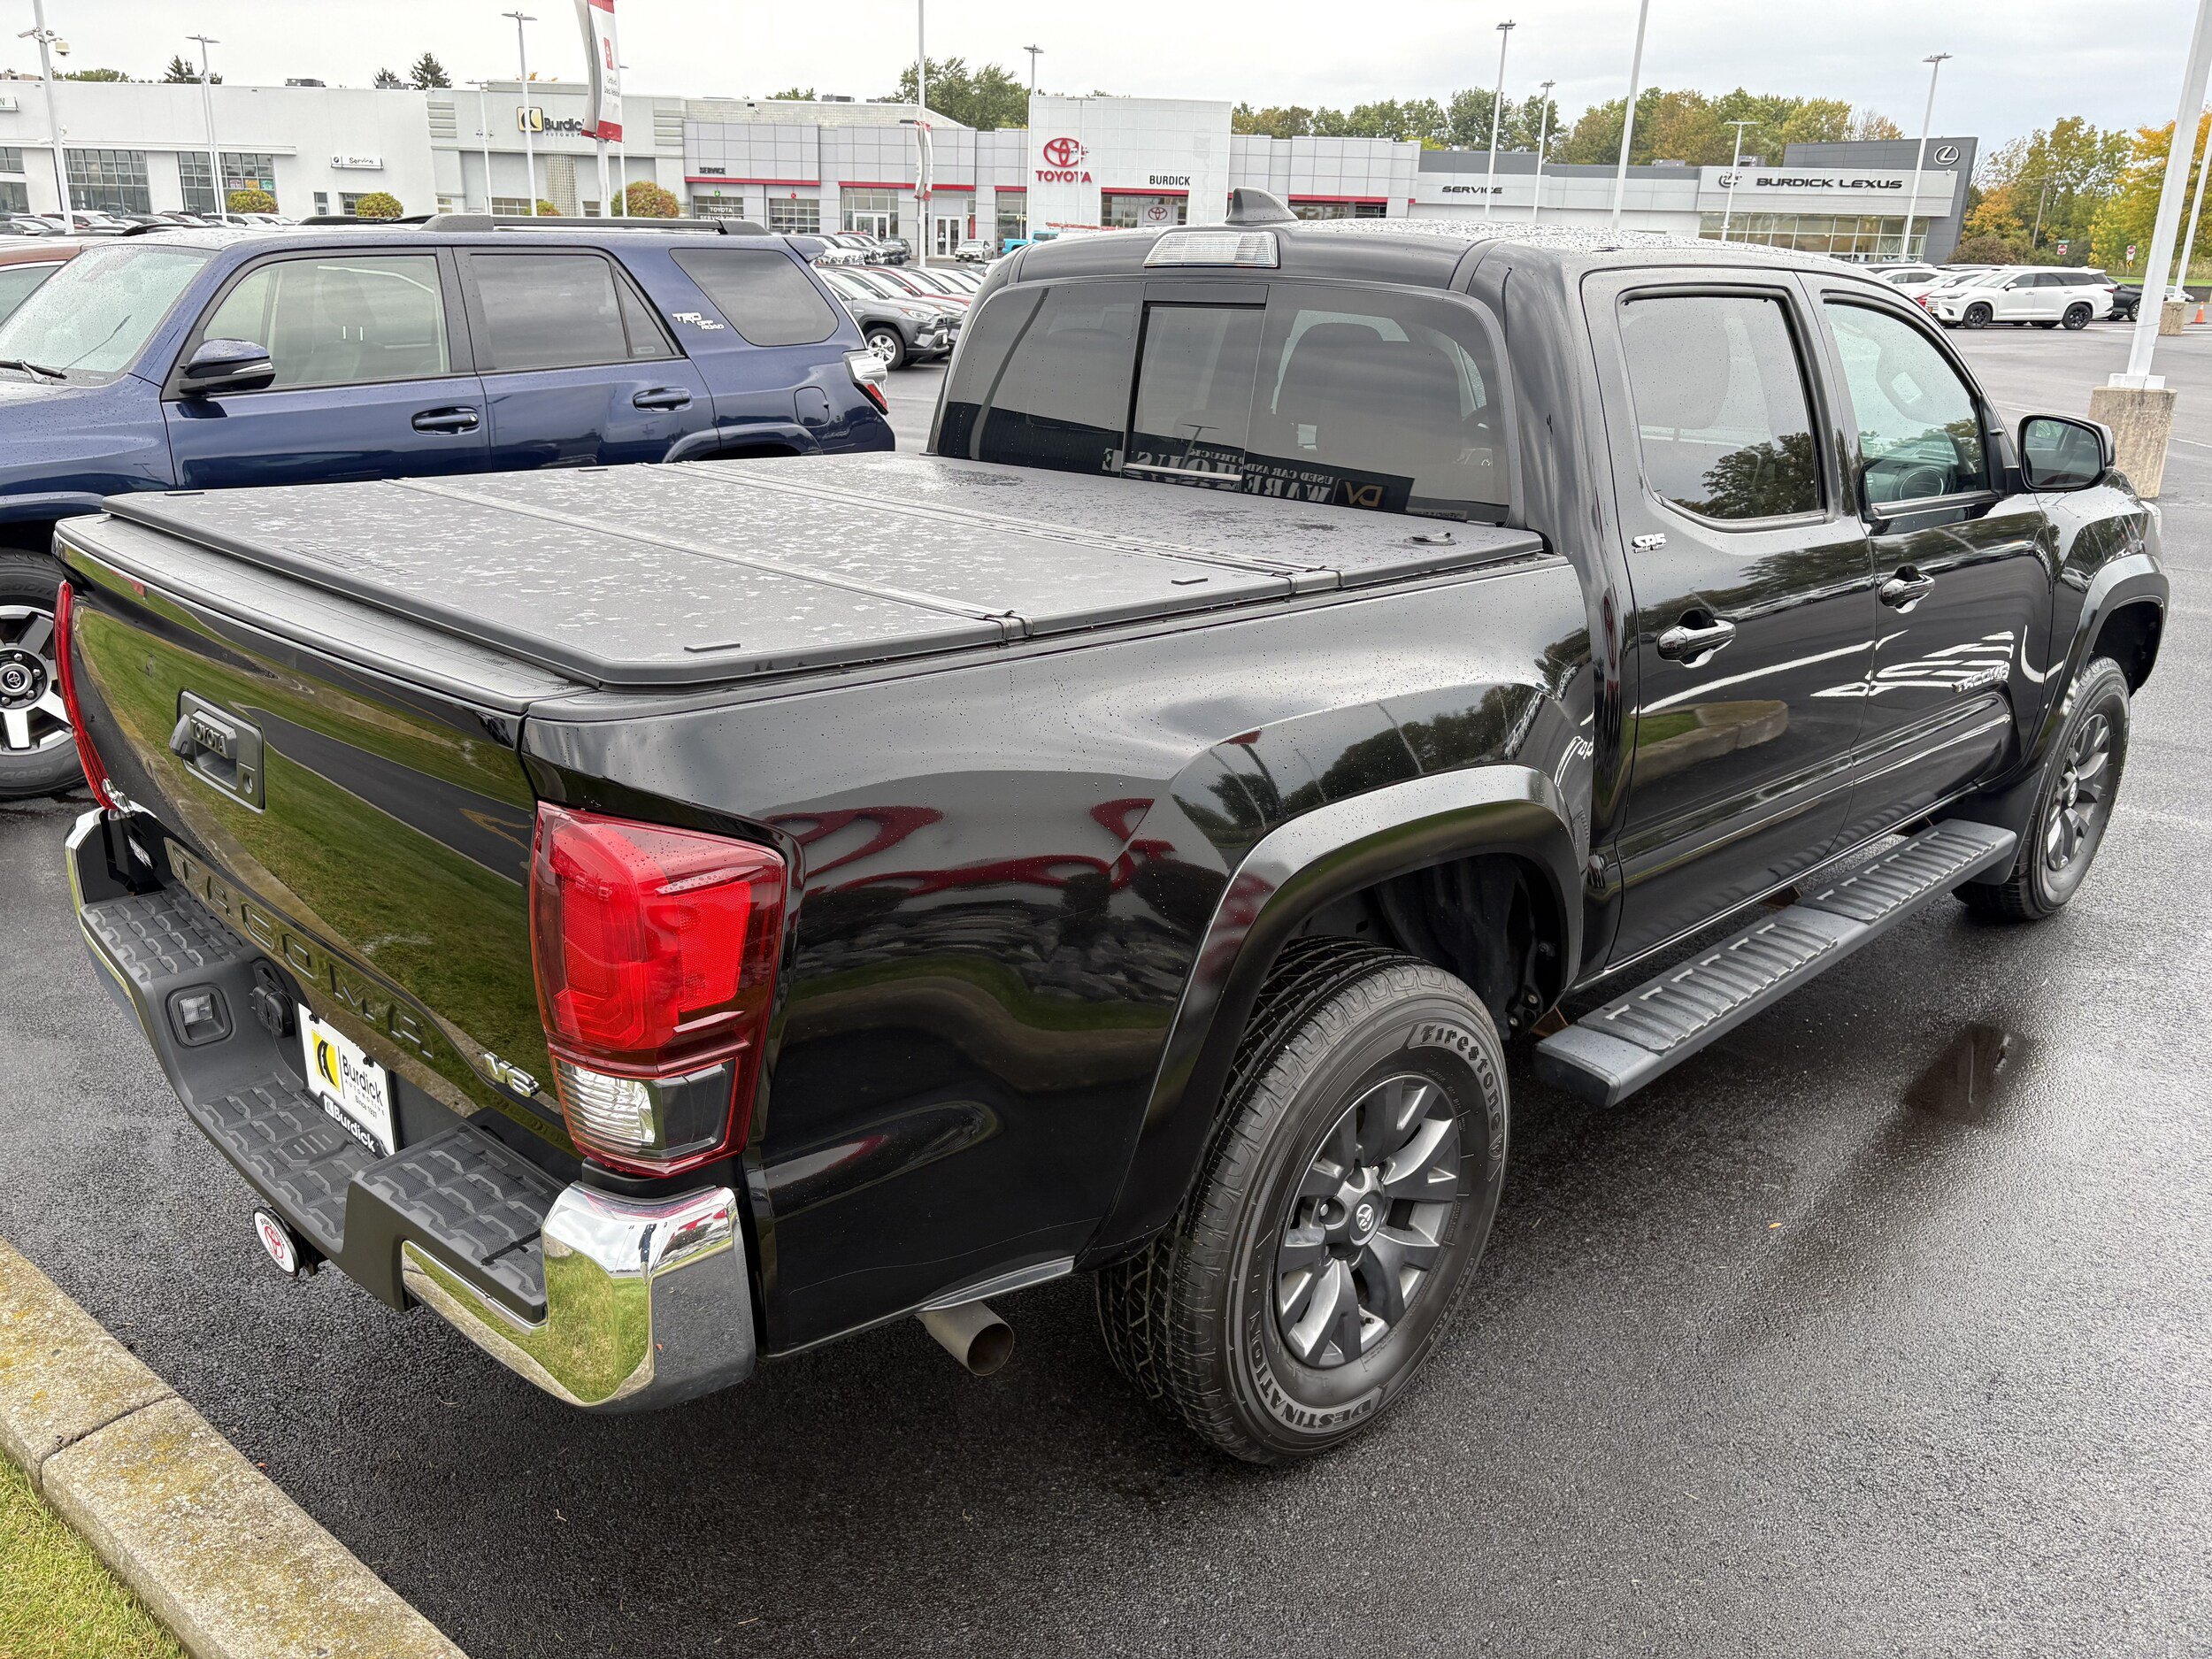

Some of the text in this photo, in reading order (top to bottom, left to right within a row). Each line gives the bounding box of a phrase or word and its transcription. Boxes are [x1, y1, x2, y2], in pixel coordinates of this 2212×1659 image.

[544, 117, 585, 132] Burdic
[699, 166, 726, 175] SERVICE
[1035, 170, 1092, 184] TOYOTA
[1149, 175, 1190, 186] BURDICK
[1756, 178, 1903, 189] BURDICK LEXUS
[672, 312, 702, 324] TRD
[1952, 663, 2010, 693] TACOMA
[190, 718, 228, 757] TOYOTA
[173, 843, 434, 1059] TACOMA
[342, 1054, 384, 1107] Burdick
[484, 1051, 540, 1097] V6
[1420, 1025, 1502, 1132] Firestone
[334, 1104, 376, 1153] Burdick
[1248, 1310, 1372, 1429] DESTINATION
